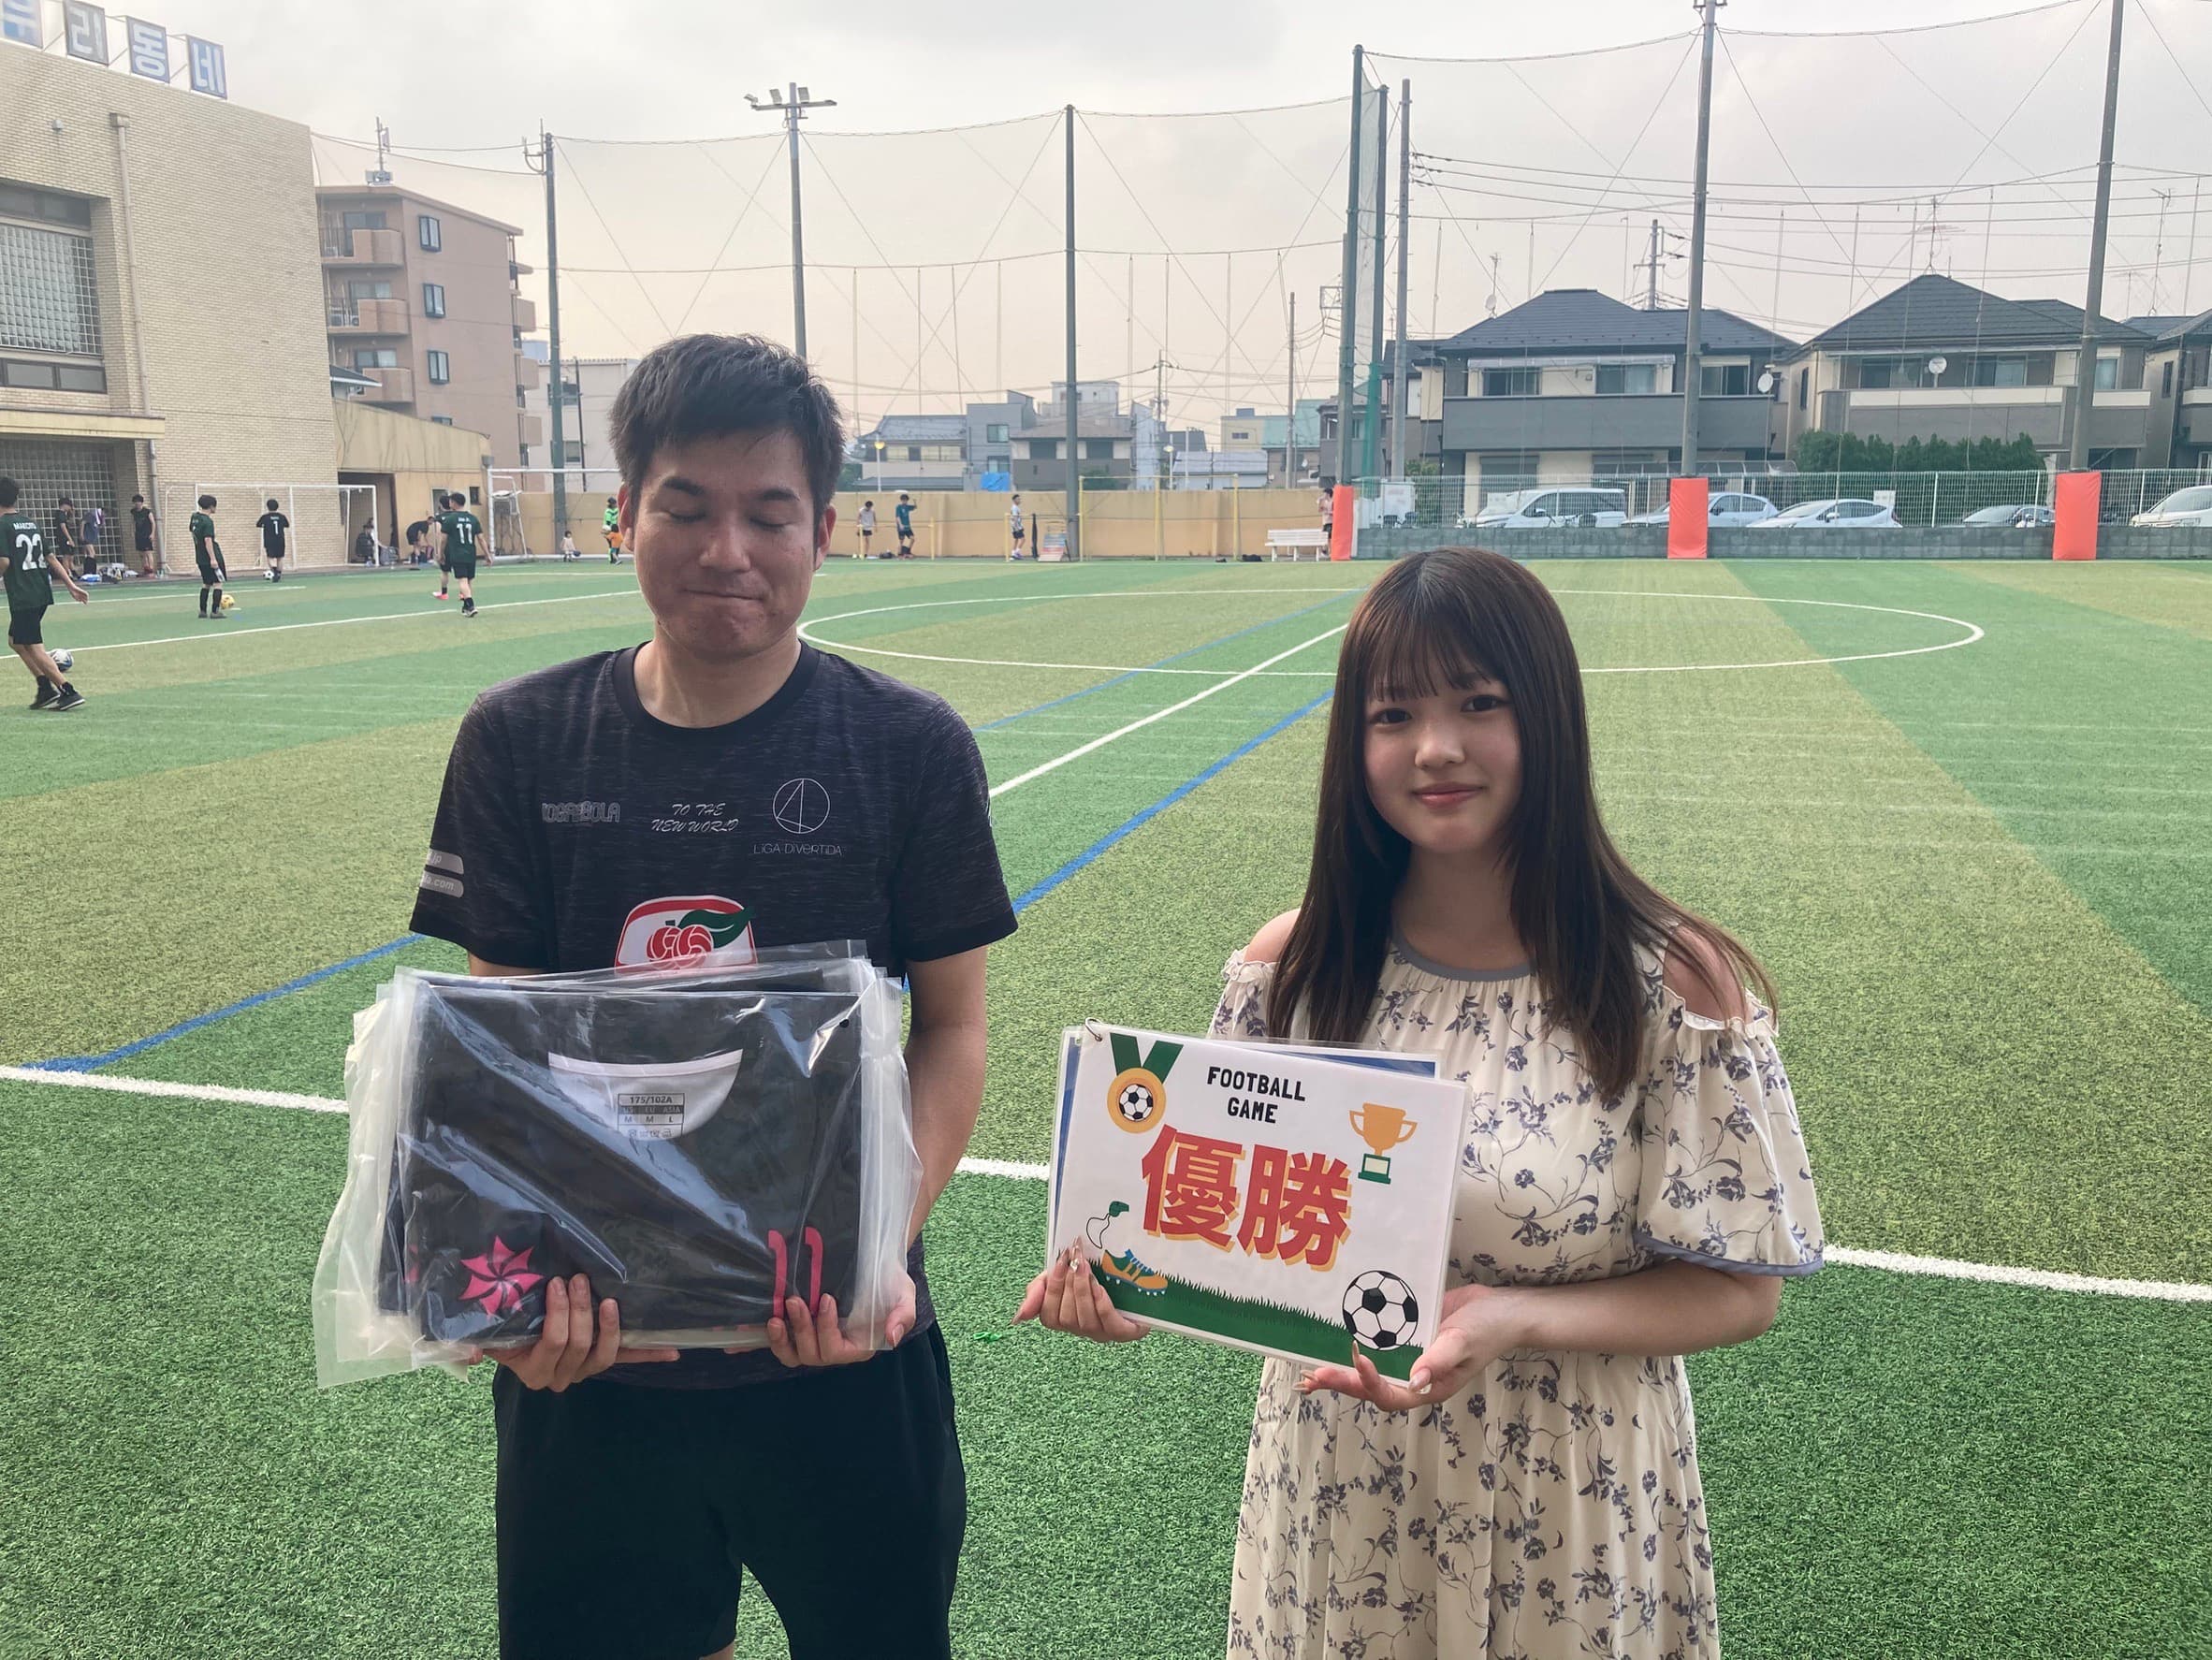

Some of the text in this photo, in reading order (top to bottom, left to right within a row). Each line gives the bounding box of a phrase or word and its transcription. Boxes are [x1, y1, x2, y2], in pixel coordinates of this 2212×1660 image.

[272, 520, 279, 535] 1
[457, 523, 473, 544] 11
[16, 533, 47, 571] 22
[672, 803, 726, 817] TO THE
[651, 818, 739, 833] NEW WORLD
[1207, 1066, 1305, 1102] FOOTBALL
[630, 1096, 673, 1104] 175/102A
[1227, 1097, 1278, 1124] GAME
[1142, 1124, 1352, 1273] 優勝
